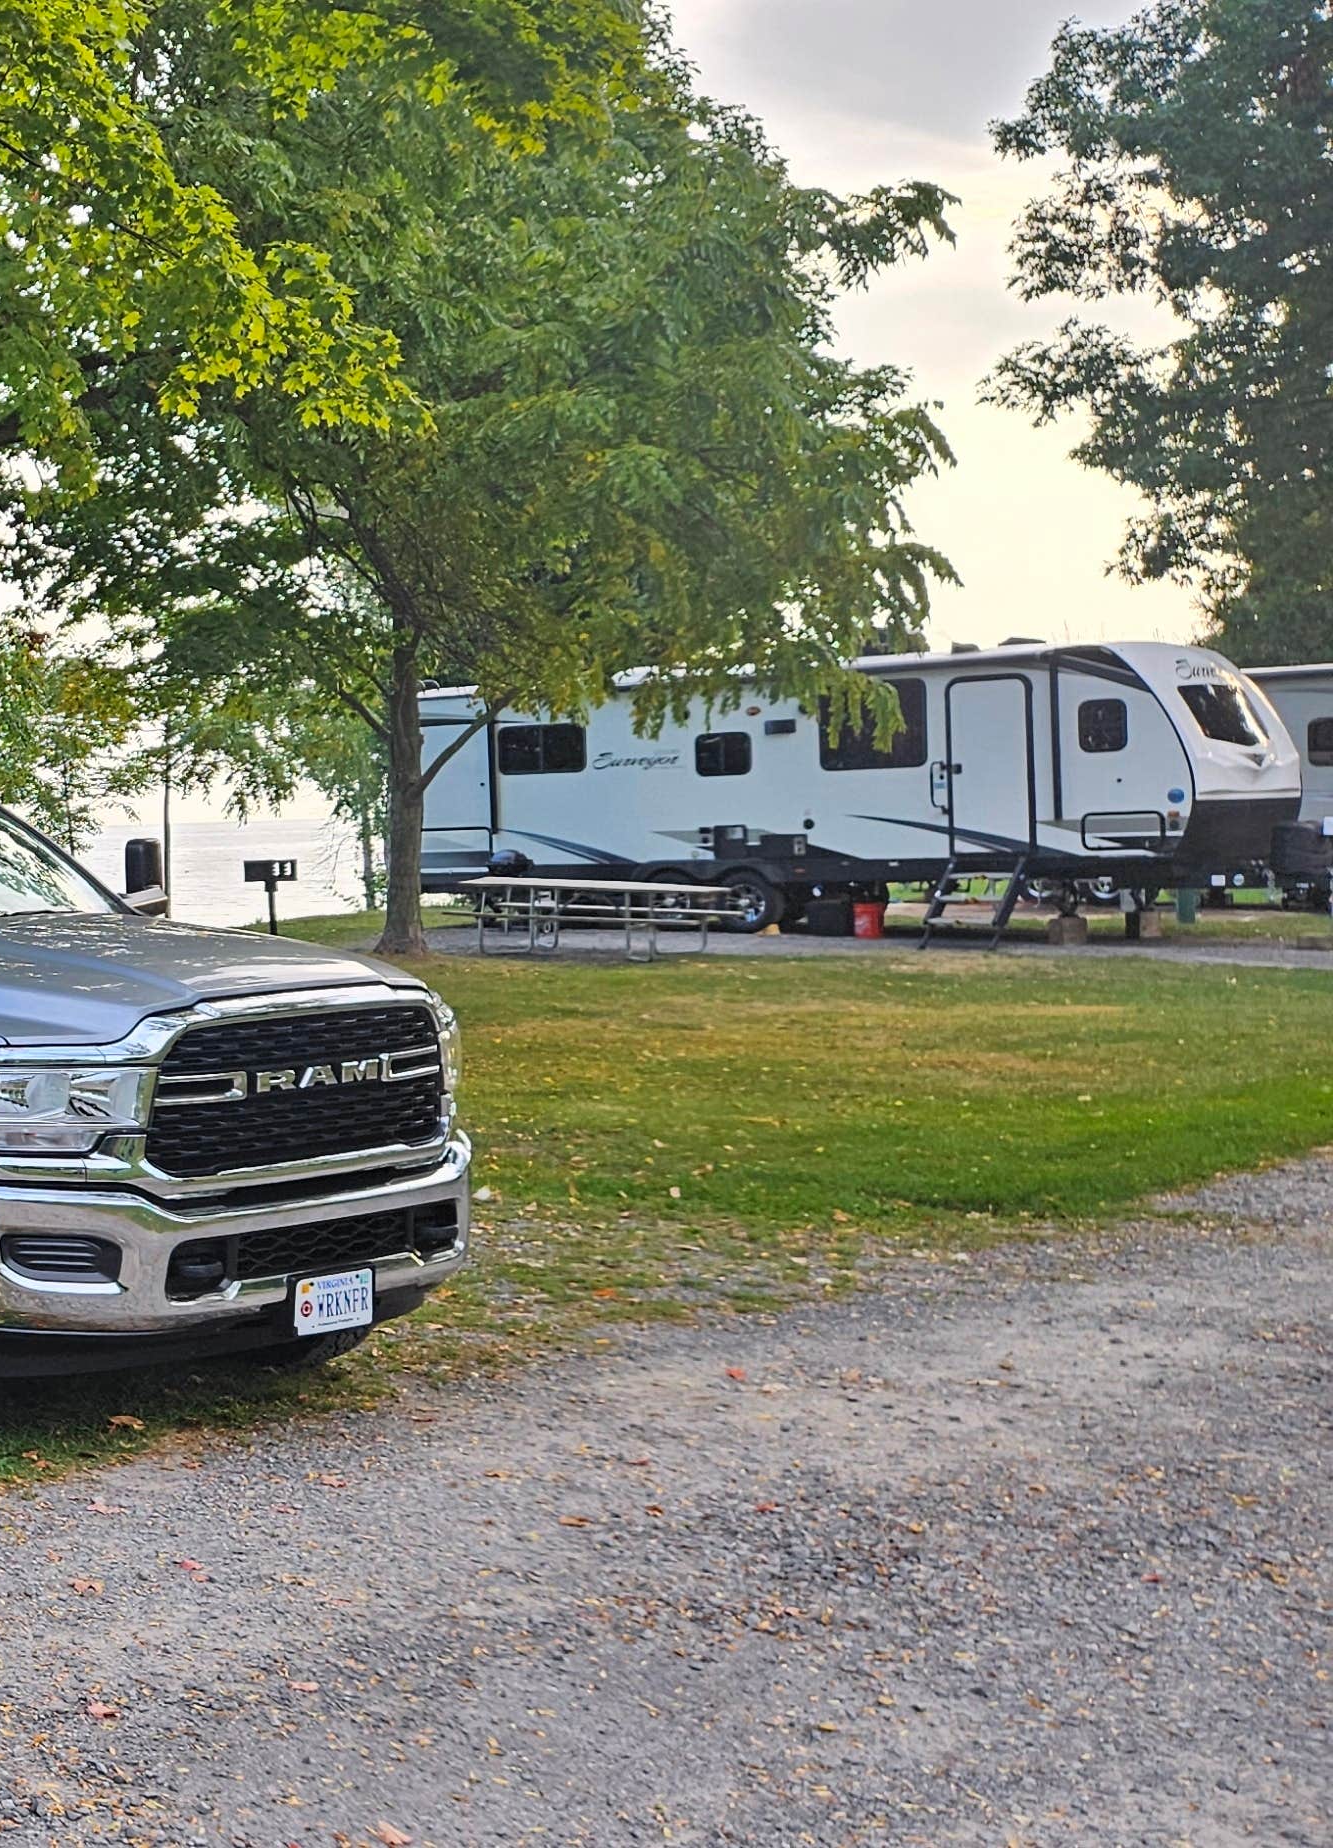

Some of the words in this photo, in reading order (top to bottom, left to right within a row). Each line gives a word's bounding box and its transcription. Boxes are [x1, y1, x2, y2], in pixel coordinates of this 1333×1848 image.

[593, 752, 679, 770] Surveyor
[256, 1058, 379, 1093] RAM
[317, 1277, 353, 1289] VIRGINIA
[317, 1287, 369, 1317] WRKNFR
